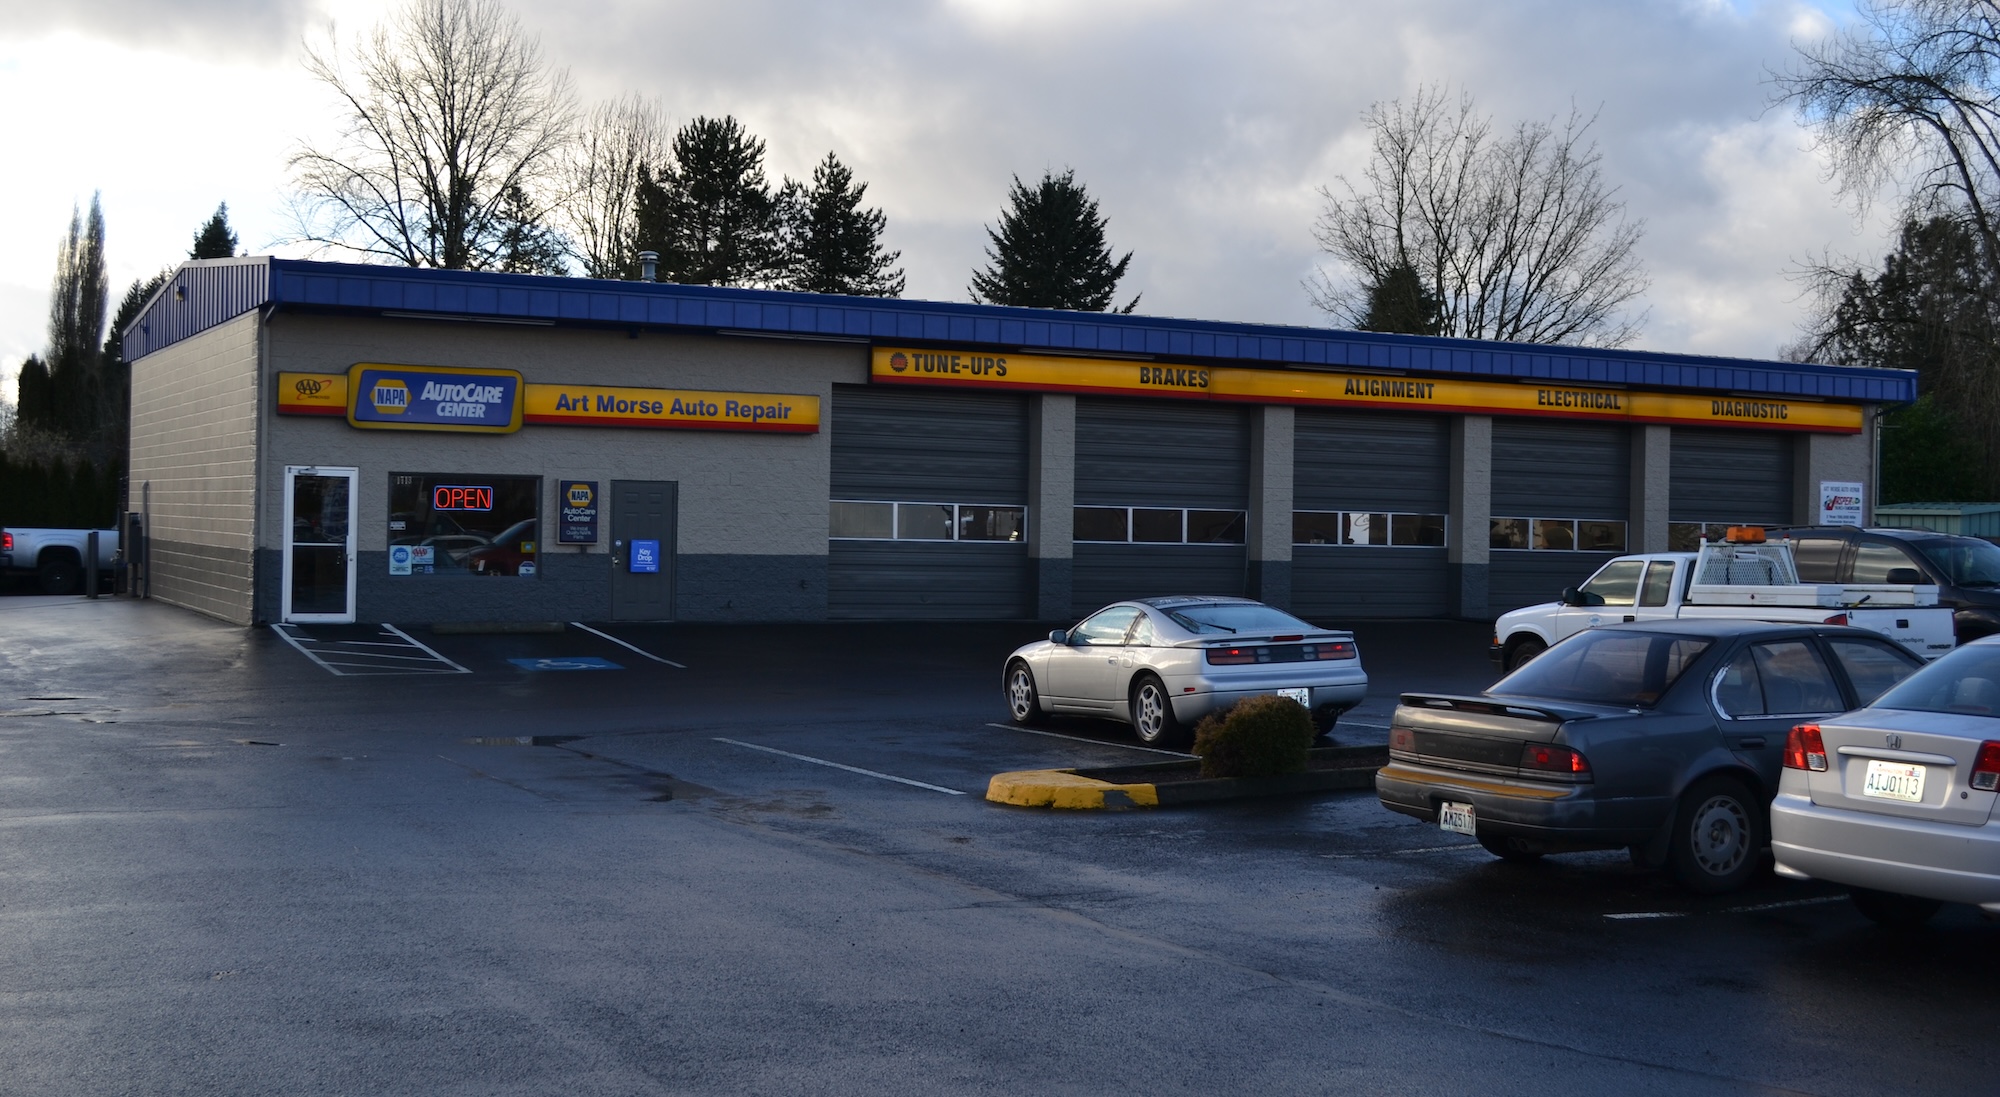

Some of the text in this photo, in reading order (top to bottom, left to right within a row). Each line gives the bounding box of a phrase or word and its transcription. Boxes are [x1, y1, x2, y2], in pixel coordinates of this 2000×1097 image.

[911, 352, 1008, 376] TUNE-UPS
[1140, 366, 1209, 388] BRAKES
[298, 379, 320, 394] AAA
[1344, 378, 1435, 400] ALIGNMENT
[376, 388, 406, 406] NAPA
[1538, 389, 1621, 410] ELECTRICAL
[436, 402, 486, 418] CENTER
[555, 393, 792, 423] Art Morse Auto Repair
[1711, 400, 1788, 420] DIAGNOSTIC
[435, 487, 491, 508] OPEN
[571, 490, 589, 501] NAPA
[563, 507, 596, 515] AutoCare
[637, 554, 653, 562] Drop
[639, 548, 651, 556] Key
[1848, 611, 1853, 620] 4
